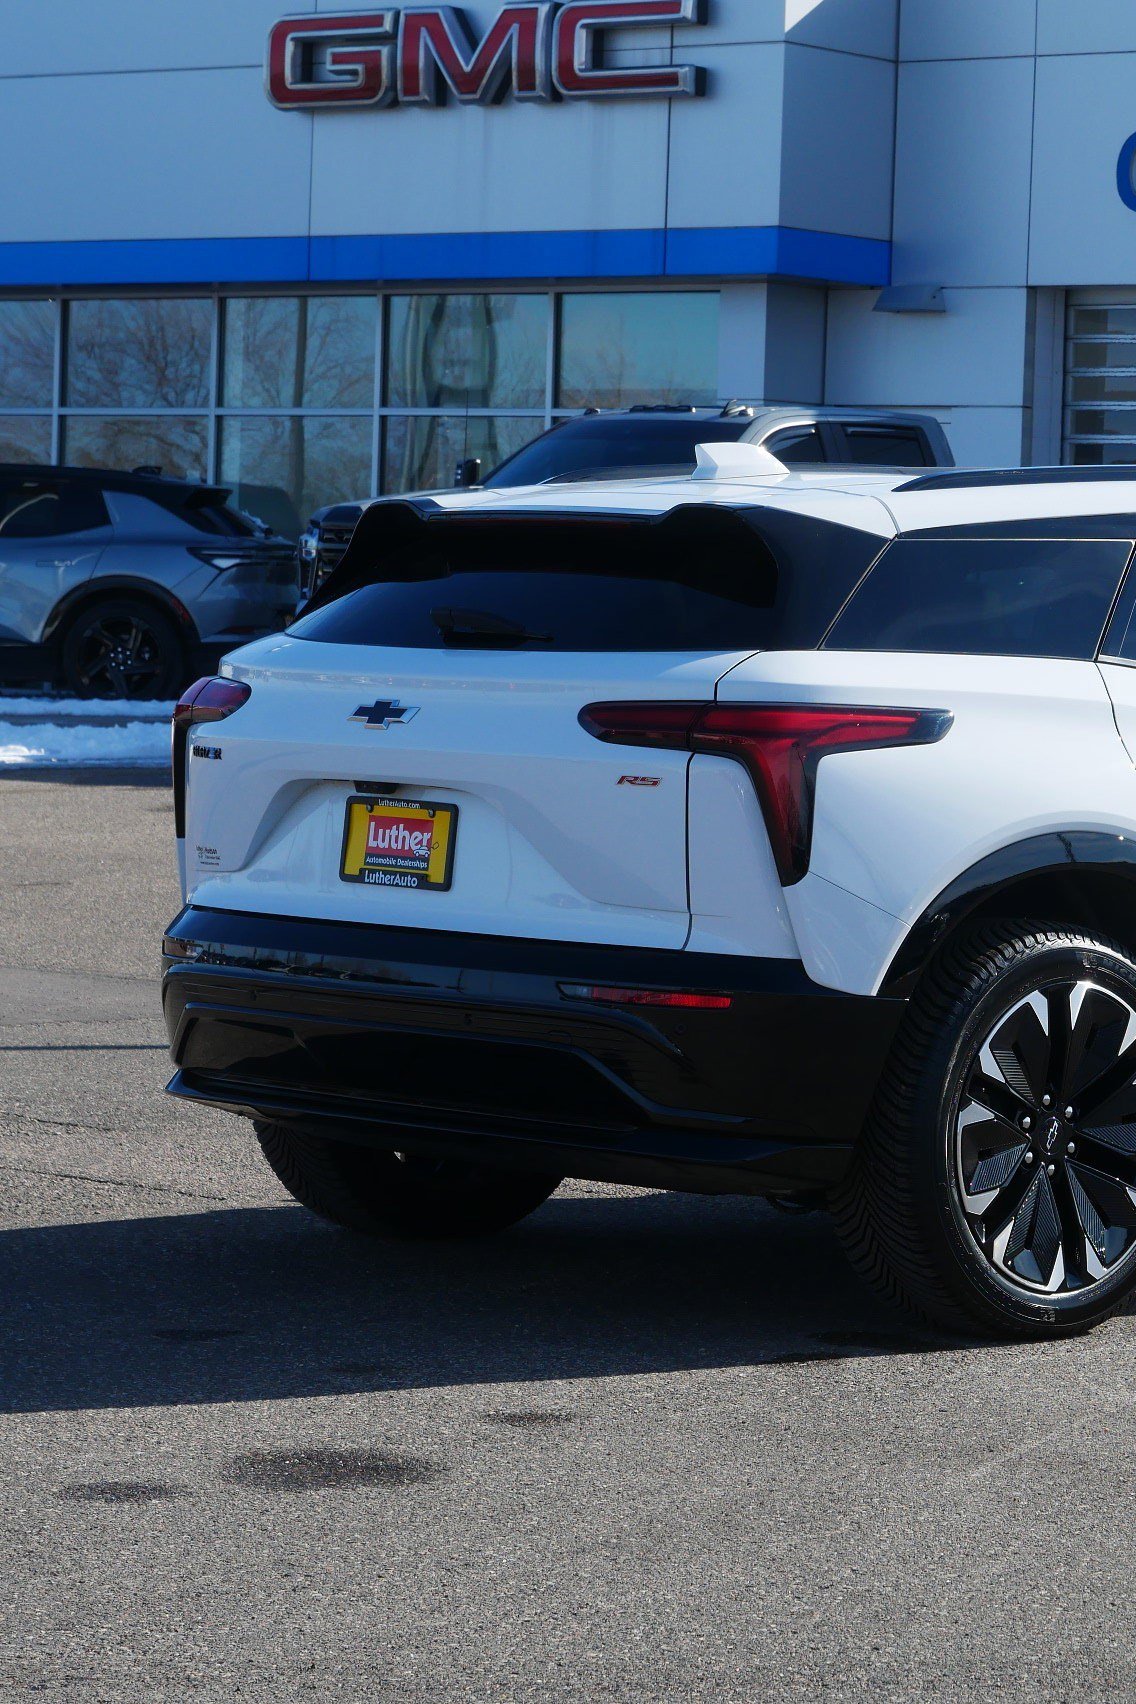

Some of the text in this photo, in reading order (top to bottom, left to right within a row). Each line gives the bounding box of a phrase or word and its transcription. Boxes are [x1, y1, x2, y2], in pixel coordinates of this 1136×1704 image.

[265, 0, 706, 111] GMC
[616, 775, 662, 787] RS
[378, 799, 420, 809] LutherAuto.com
[368, 821, 431, 851] Luther
[366, 856, 427, 868] Automobile Dealerships
[364, 870, 418, 887] LutherAuto
